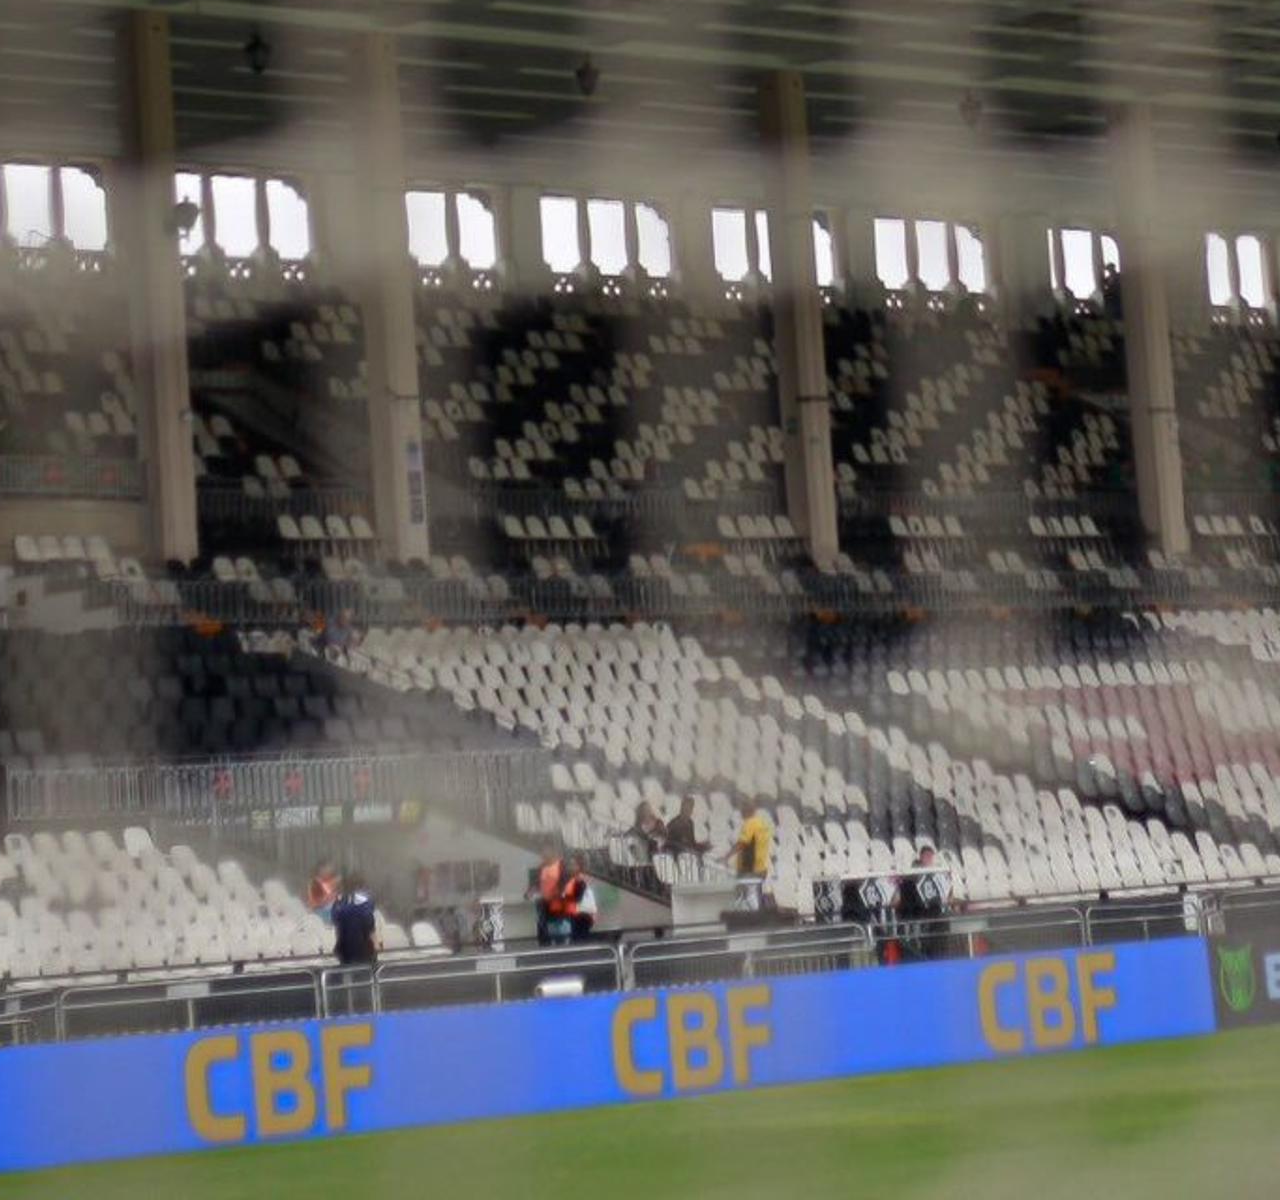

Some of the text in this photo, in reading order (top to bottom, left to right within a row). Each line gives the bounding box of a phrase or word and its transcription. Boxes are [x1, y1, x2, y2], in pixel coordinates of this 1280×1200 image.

[610, 985, 774, 1096] CBF
[977, 951, 1116, 1053] CBF
[183, 1022, 376, 1143] CBF
